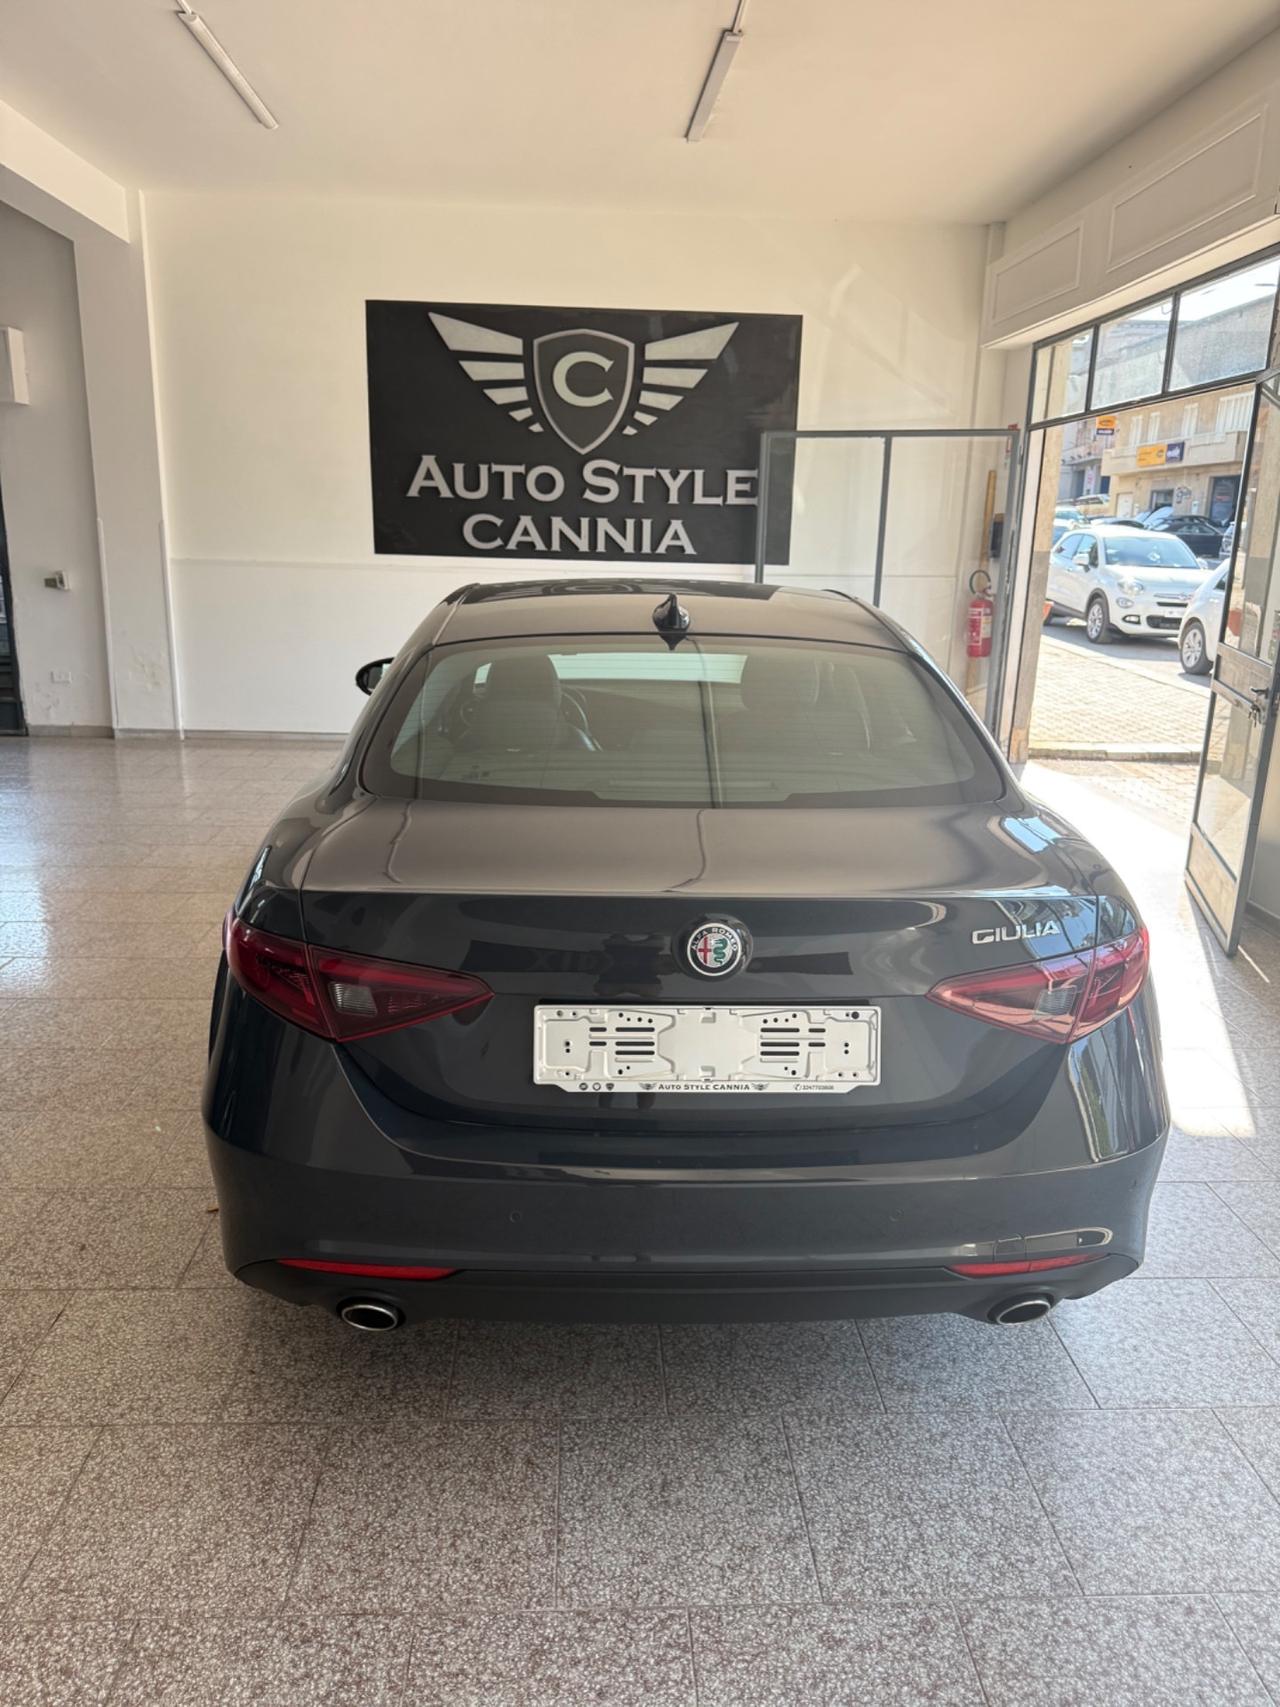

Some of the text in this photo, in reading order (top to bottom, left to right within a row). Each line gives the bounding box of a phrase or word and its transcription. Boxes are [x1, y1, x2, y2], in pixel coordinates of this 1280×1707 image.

[552, 351, 614, 407] C
[406, 455, 759, 506] AUTO STYLE
[462, 513, 697, 555] CANNIA
[691, 927, 738, 951] ALFA ROMEO
[972, 920, 1060, 944] GIULIA
[658, 1083, 682, 1091] AUTO
[683, 1083, 711, 1091] STYLE
[712, 1083, 750, 1091] CANNIA
